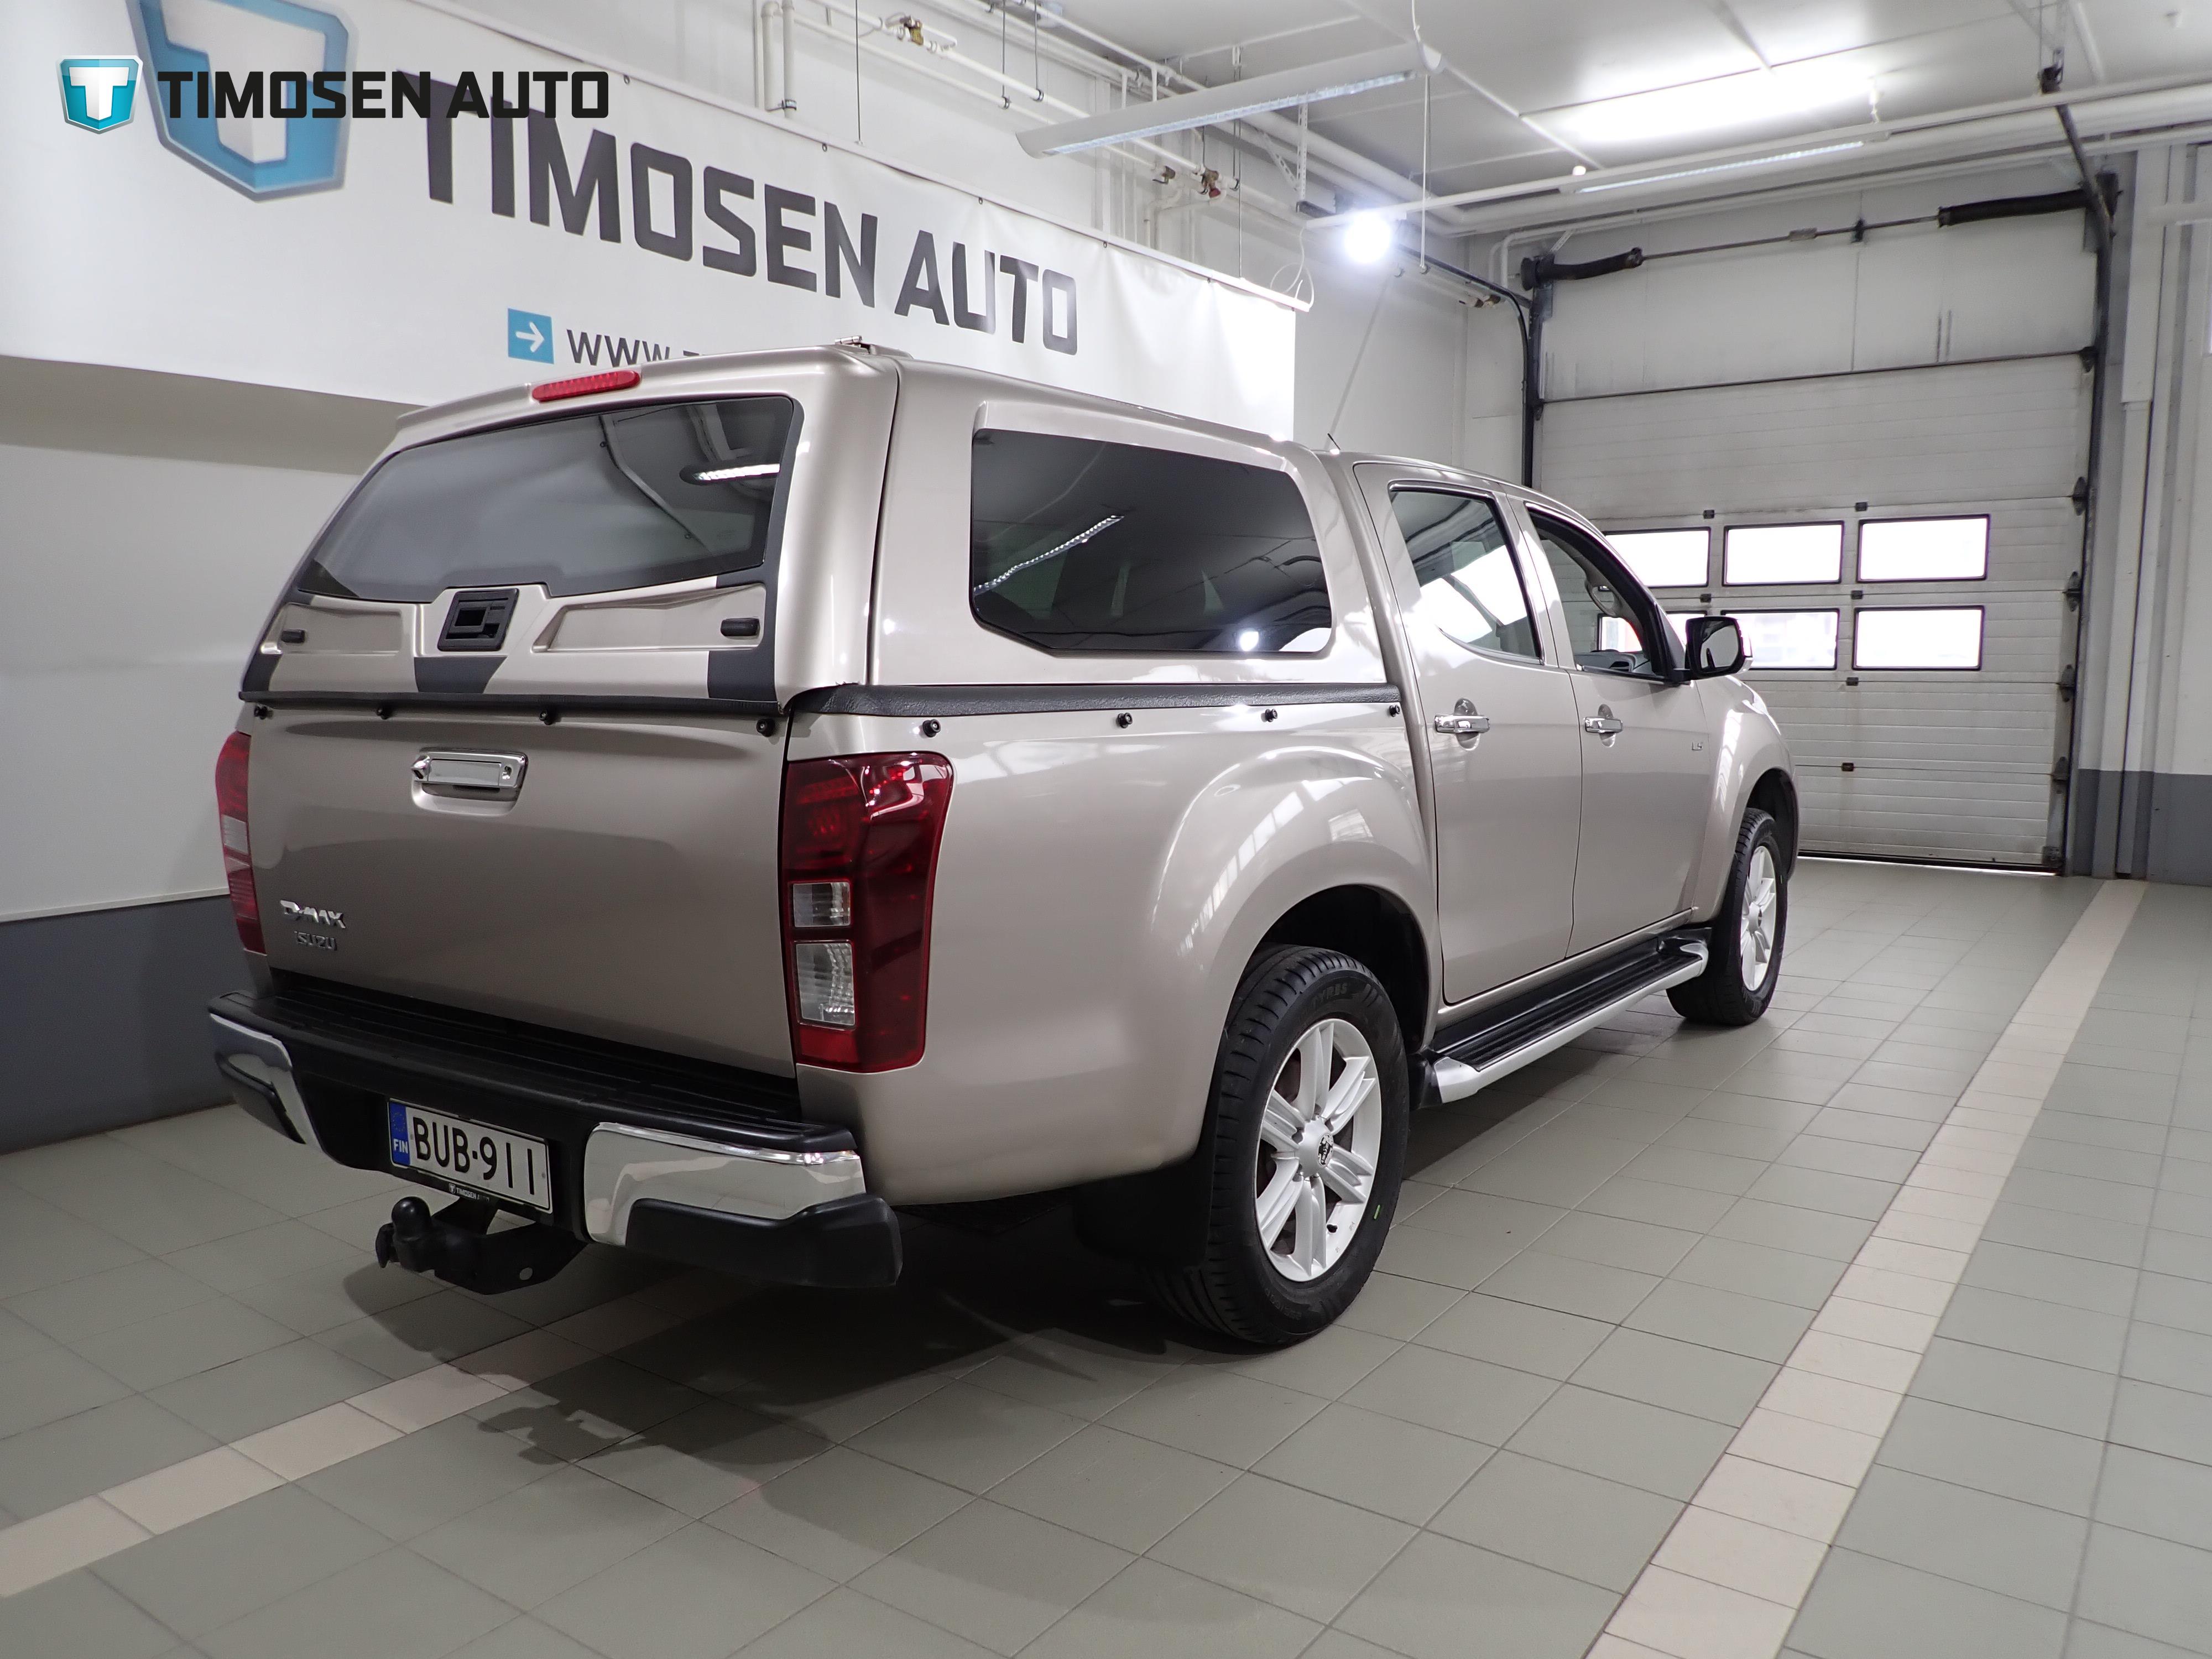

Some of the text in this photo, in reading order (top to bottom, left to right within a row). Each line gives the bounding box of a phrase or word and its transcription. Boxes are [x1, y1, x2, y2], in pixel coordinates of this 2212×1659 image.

[397, 70, 1077, 356] TIMOSEN AUTO
[280, 900, 346, 928] D-MAX
[393, 1138, 408, 1154] FIN
[413, 1117, 535, 1196] BUB-911
